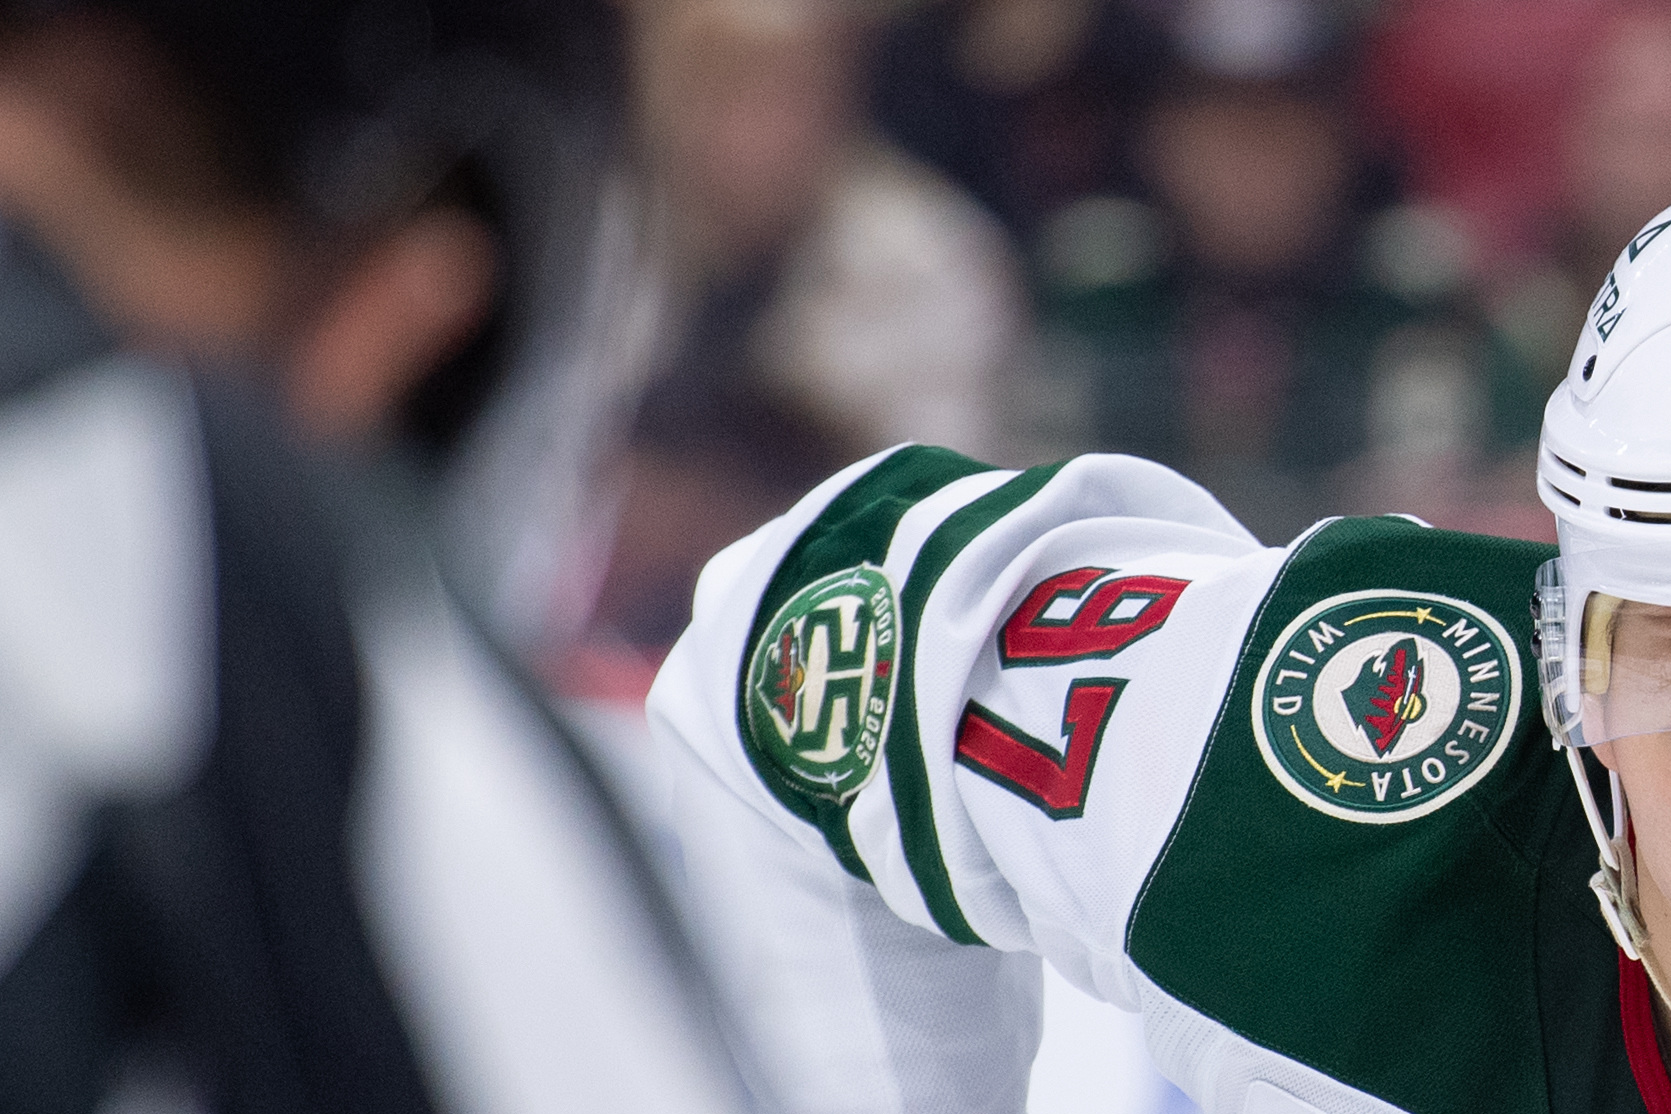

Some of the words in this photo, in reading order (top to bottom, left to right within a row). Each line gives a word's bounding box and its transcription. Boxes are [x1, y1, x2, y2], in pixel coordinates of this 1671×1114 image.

[870, 586, 893, 647] 2000
[954, 566, 1192, 821] 97
[1273, 620, 1345, 716] WILD
[1371, 617, 1500, 801] MINNESOTA
[856, 696, 885, 767] 2025
